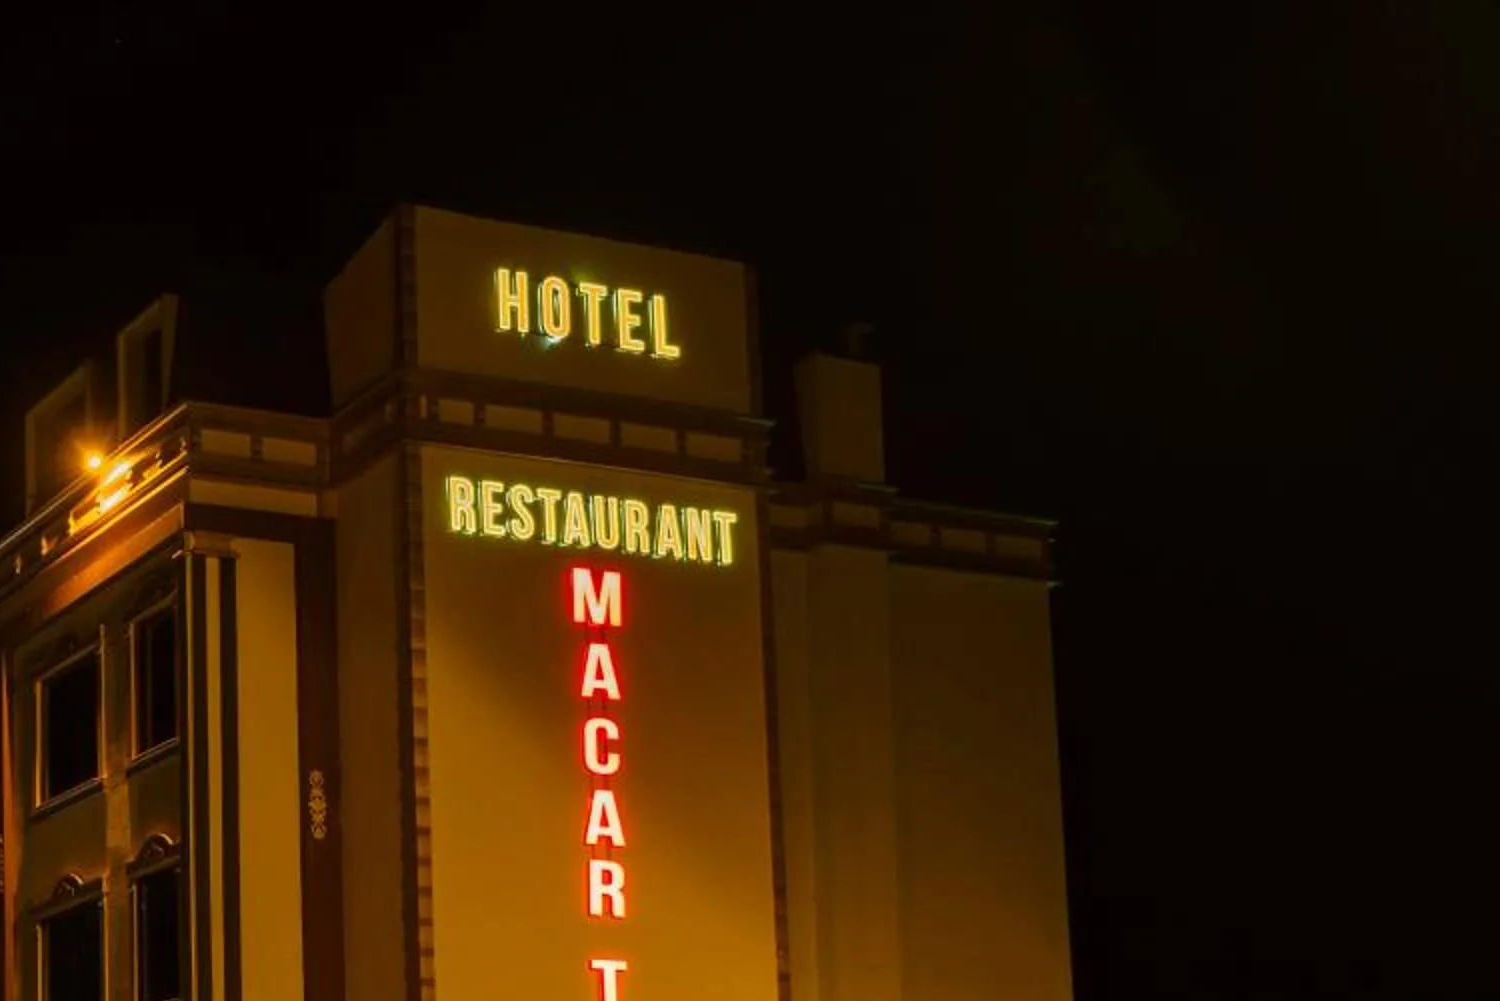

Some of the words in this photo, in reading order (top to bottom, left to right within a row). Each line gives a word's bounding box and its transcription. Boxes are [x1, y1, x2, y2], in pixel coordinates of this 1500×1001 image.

[495, 268, 681, 358] HOTEL
[448, 475, 738, 566] RESTAURANT
[572, 567, 626, 918] MACAR
